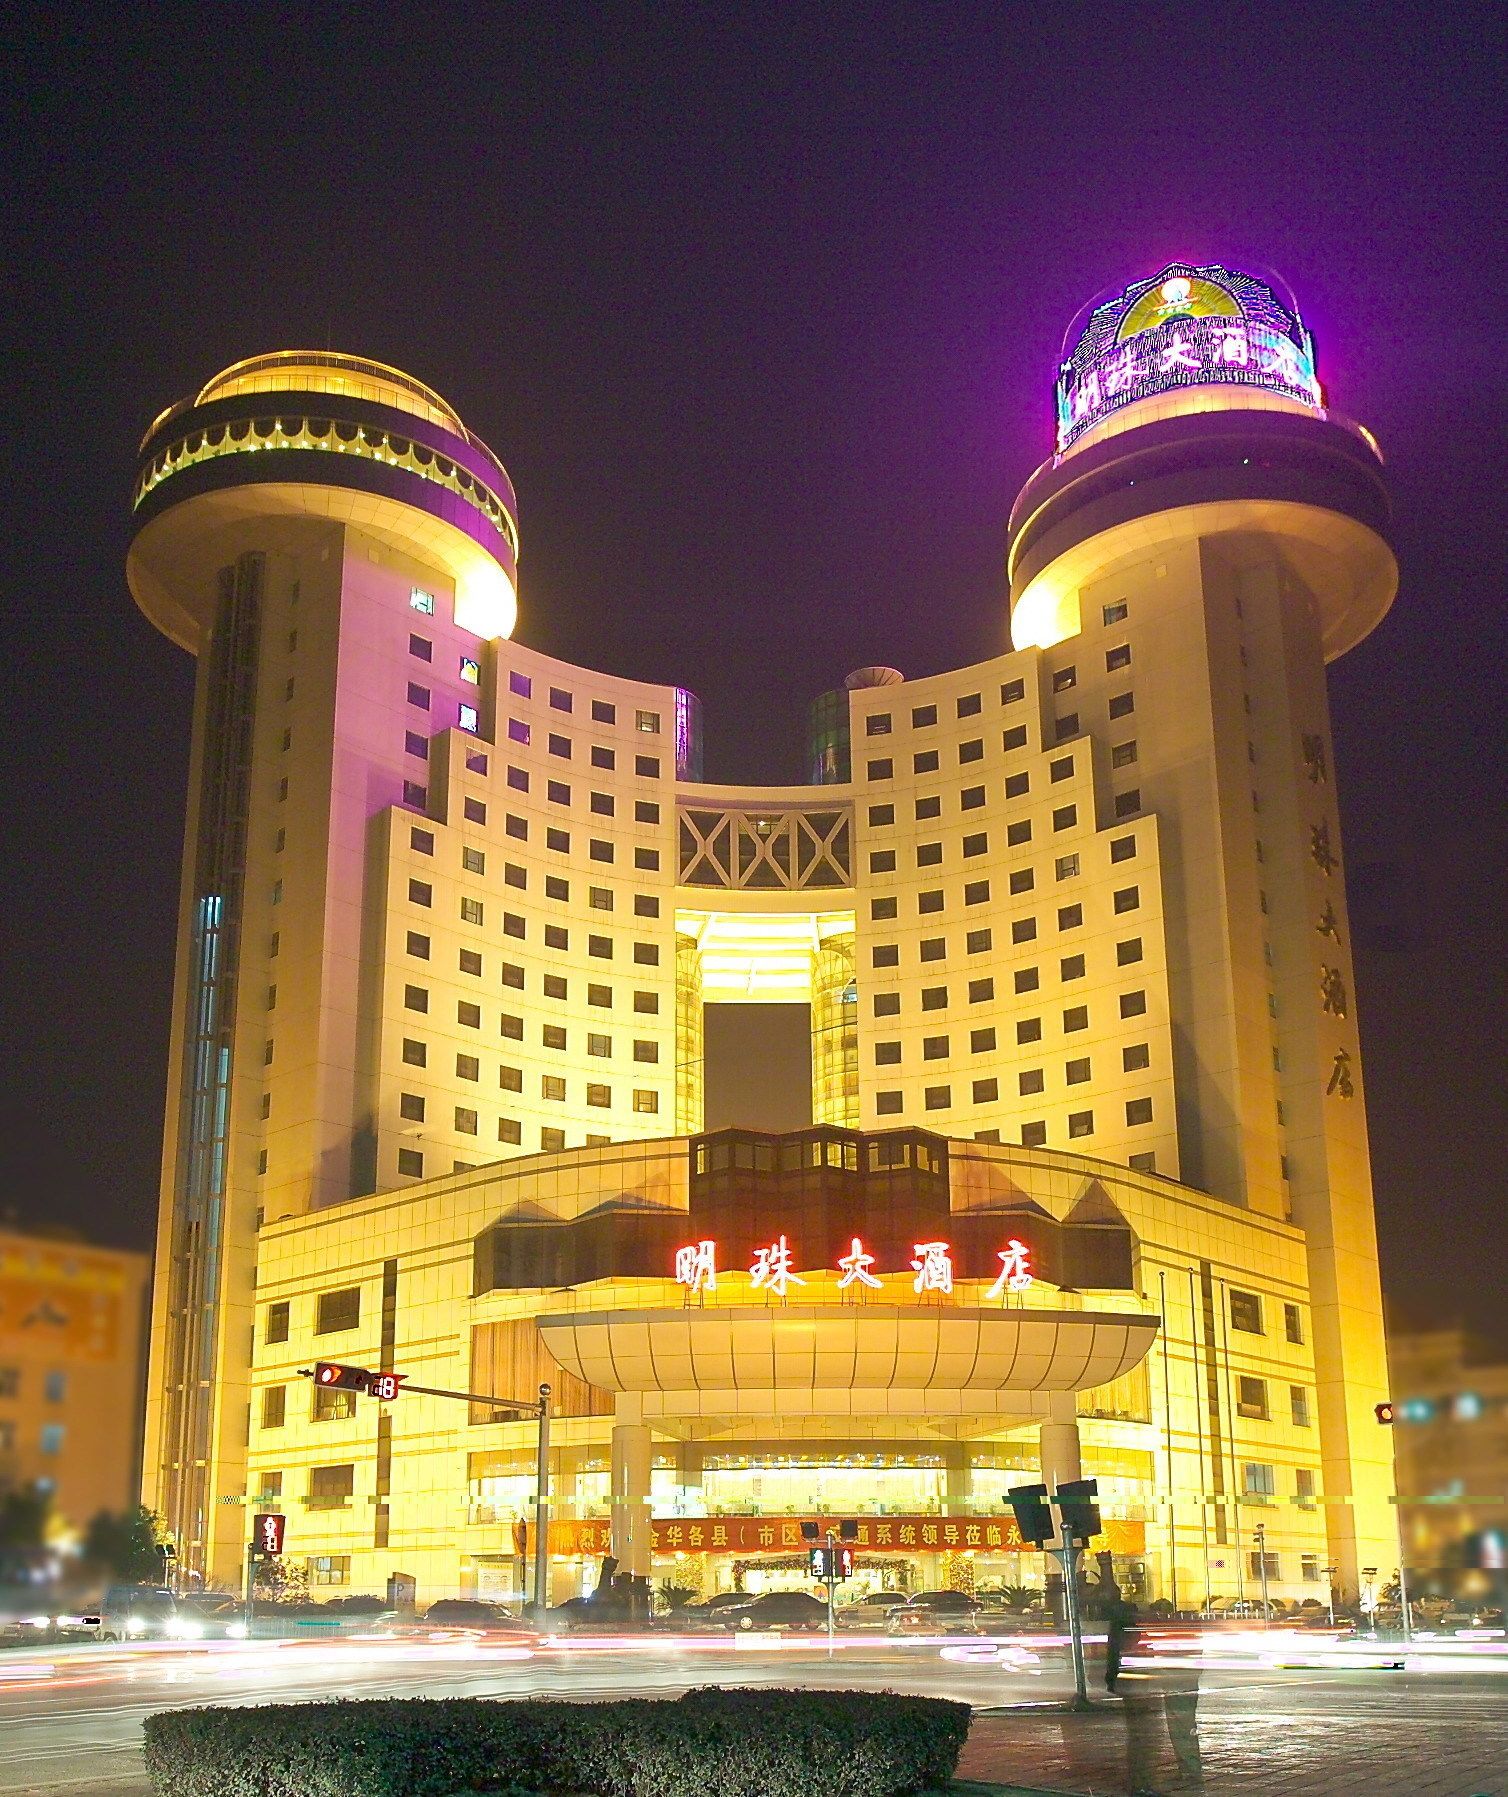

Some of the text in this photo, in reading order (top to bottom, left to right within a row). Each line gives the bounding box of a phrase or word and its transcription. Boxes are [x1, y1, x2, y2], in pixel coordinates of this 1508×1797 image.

[675, 1234, 1033, 1299] 明珠大酒店
